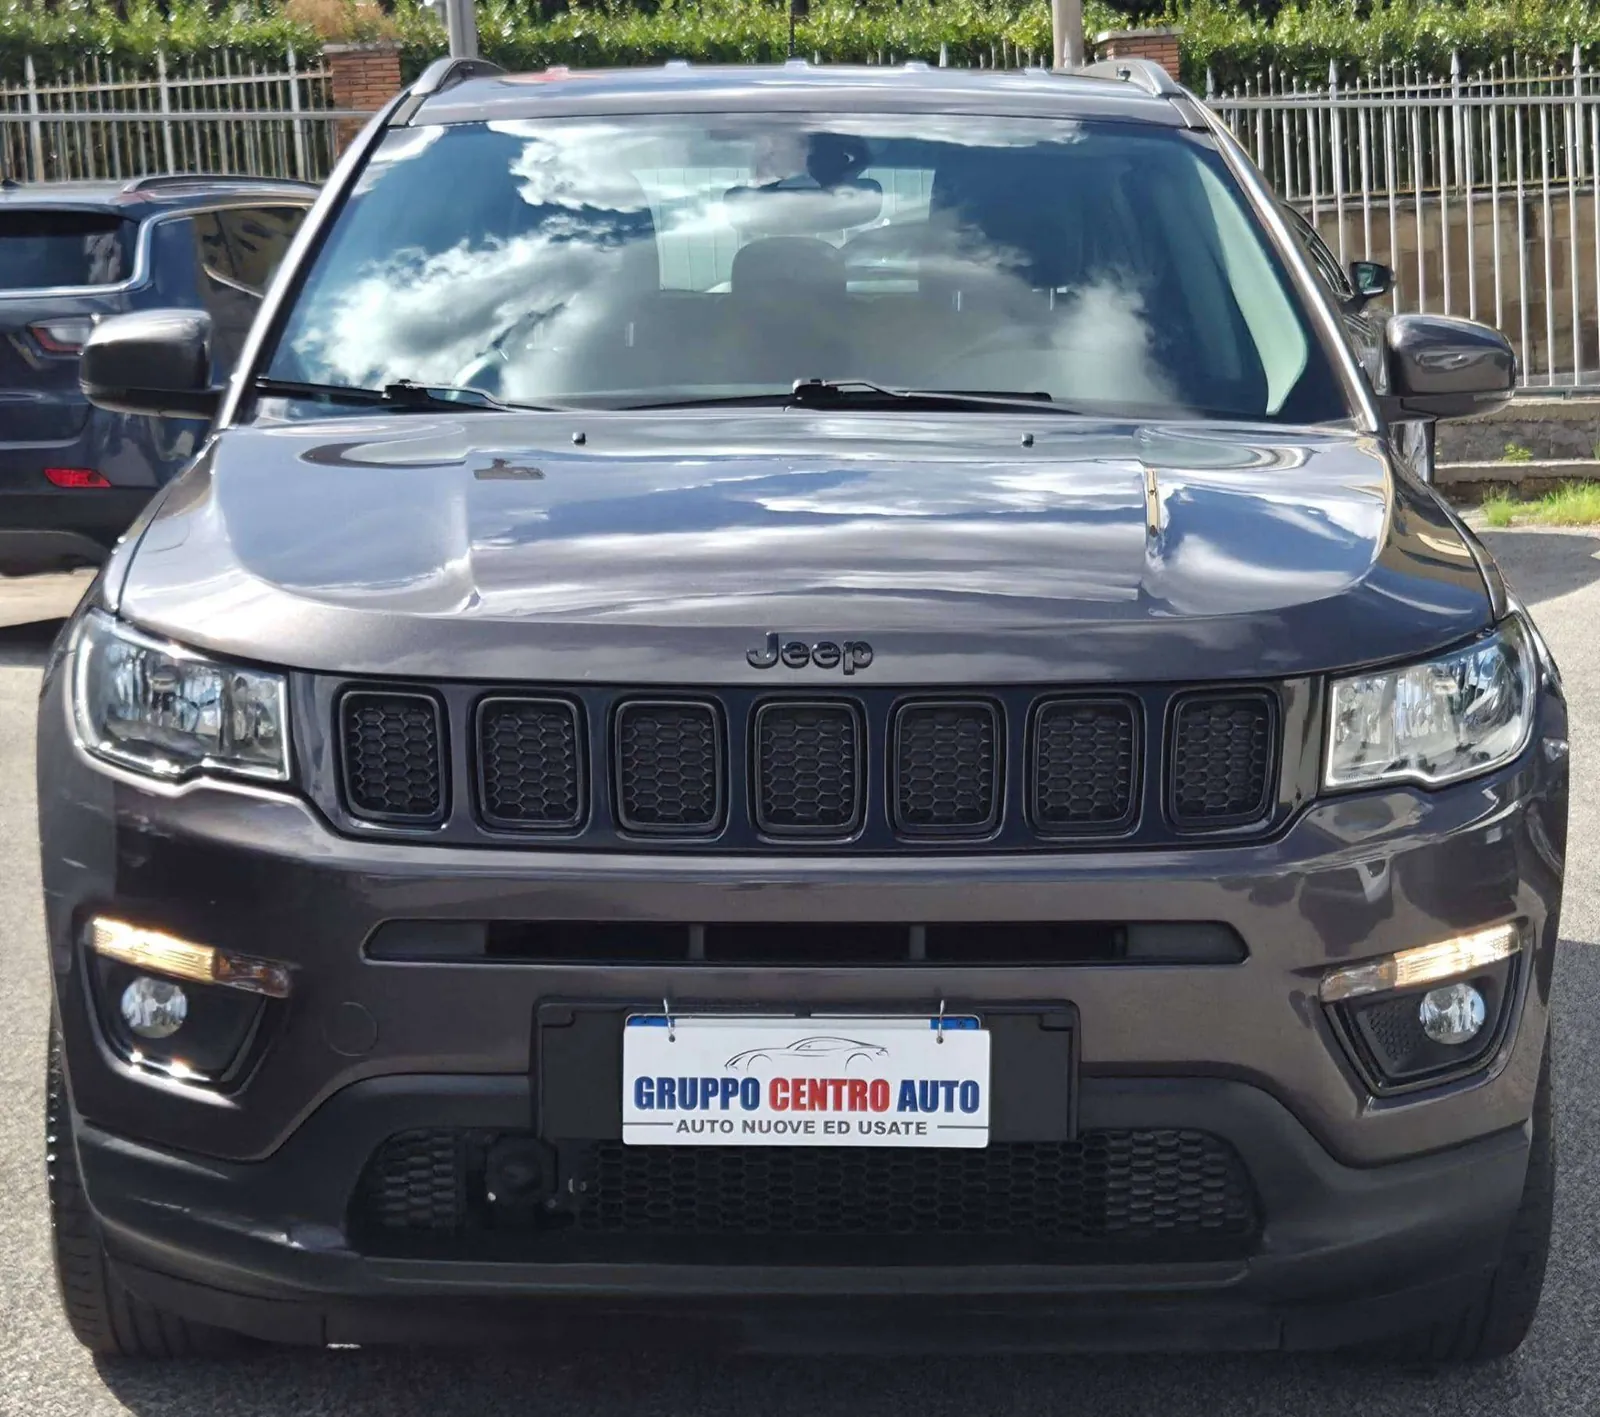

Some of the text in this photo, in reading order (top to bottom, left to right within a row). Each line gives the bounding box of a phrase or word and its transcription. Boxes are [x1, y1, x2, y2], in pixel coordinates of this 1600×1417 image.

[746, 631, 873, 675] Jeep
[633, 1076, 980, 1114] GRUPPO CENTRO AUTO
[676, 1119, 928, 1136] AUTO NUOVE ED USATE
